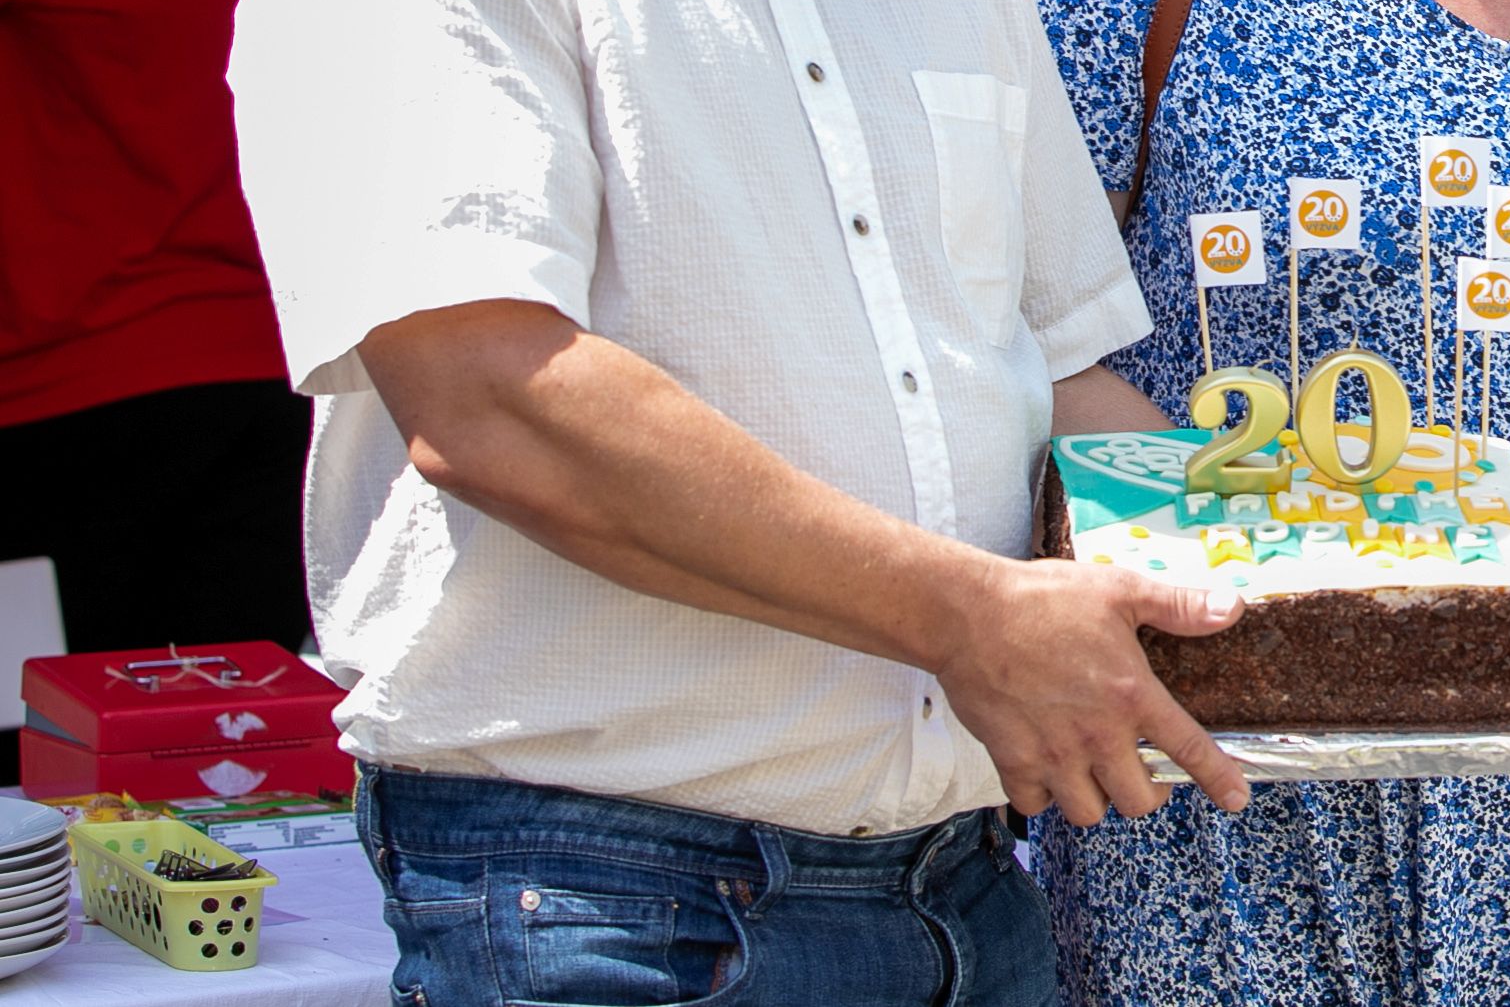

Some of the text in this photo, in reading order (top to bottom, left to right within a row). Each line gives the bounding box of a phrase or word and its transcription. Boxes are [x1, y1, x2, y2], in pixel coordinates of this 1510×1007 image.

[1435, 155, 1474, 182] 20
[1305, 196, 1344, 222] 20
[1206, 230, 1246, 258] 20
[1186, 350, 1411, 495] 20
